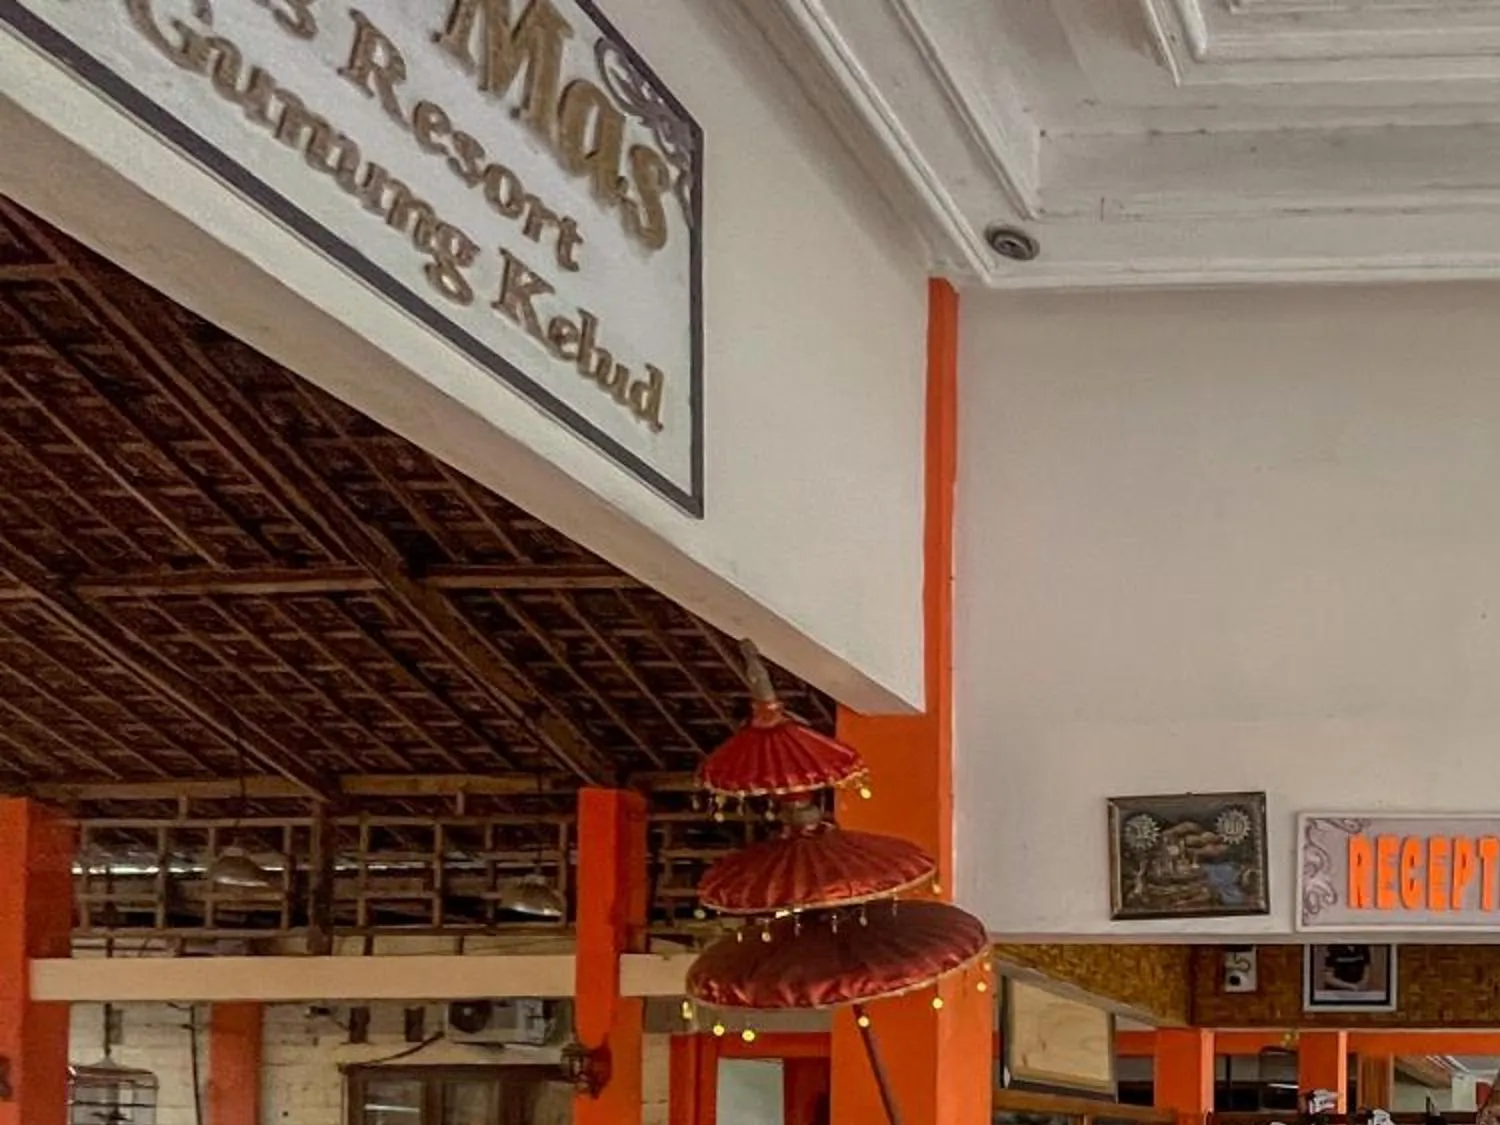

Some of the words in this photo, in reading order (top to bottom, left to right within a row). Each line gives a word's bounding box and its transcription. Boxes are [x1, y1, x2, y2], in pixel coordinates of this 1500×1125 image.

[126, 0, 480, 306] Gunung
[491, 247, 665, 434] Kelud
[338, 9, 583, 272] Resort
